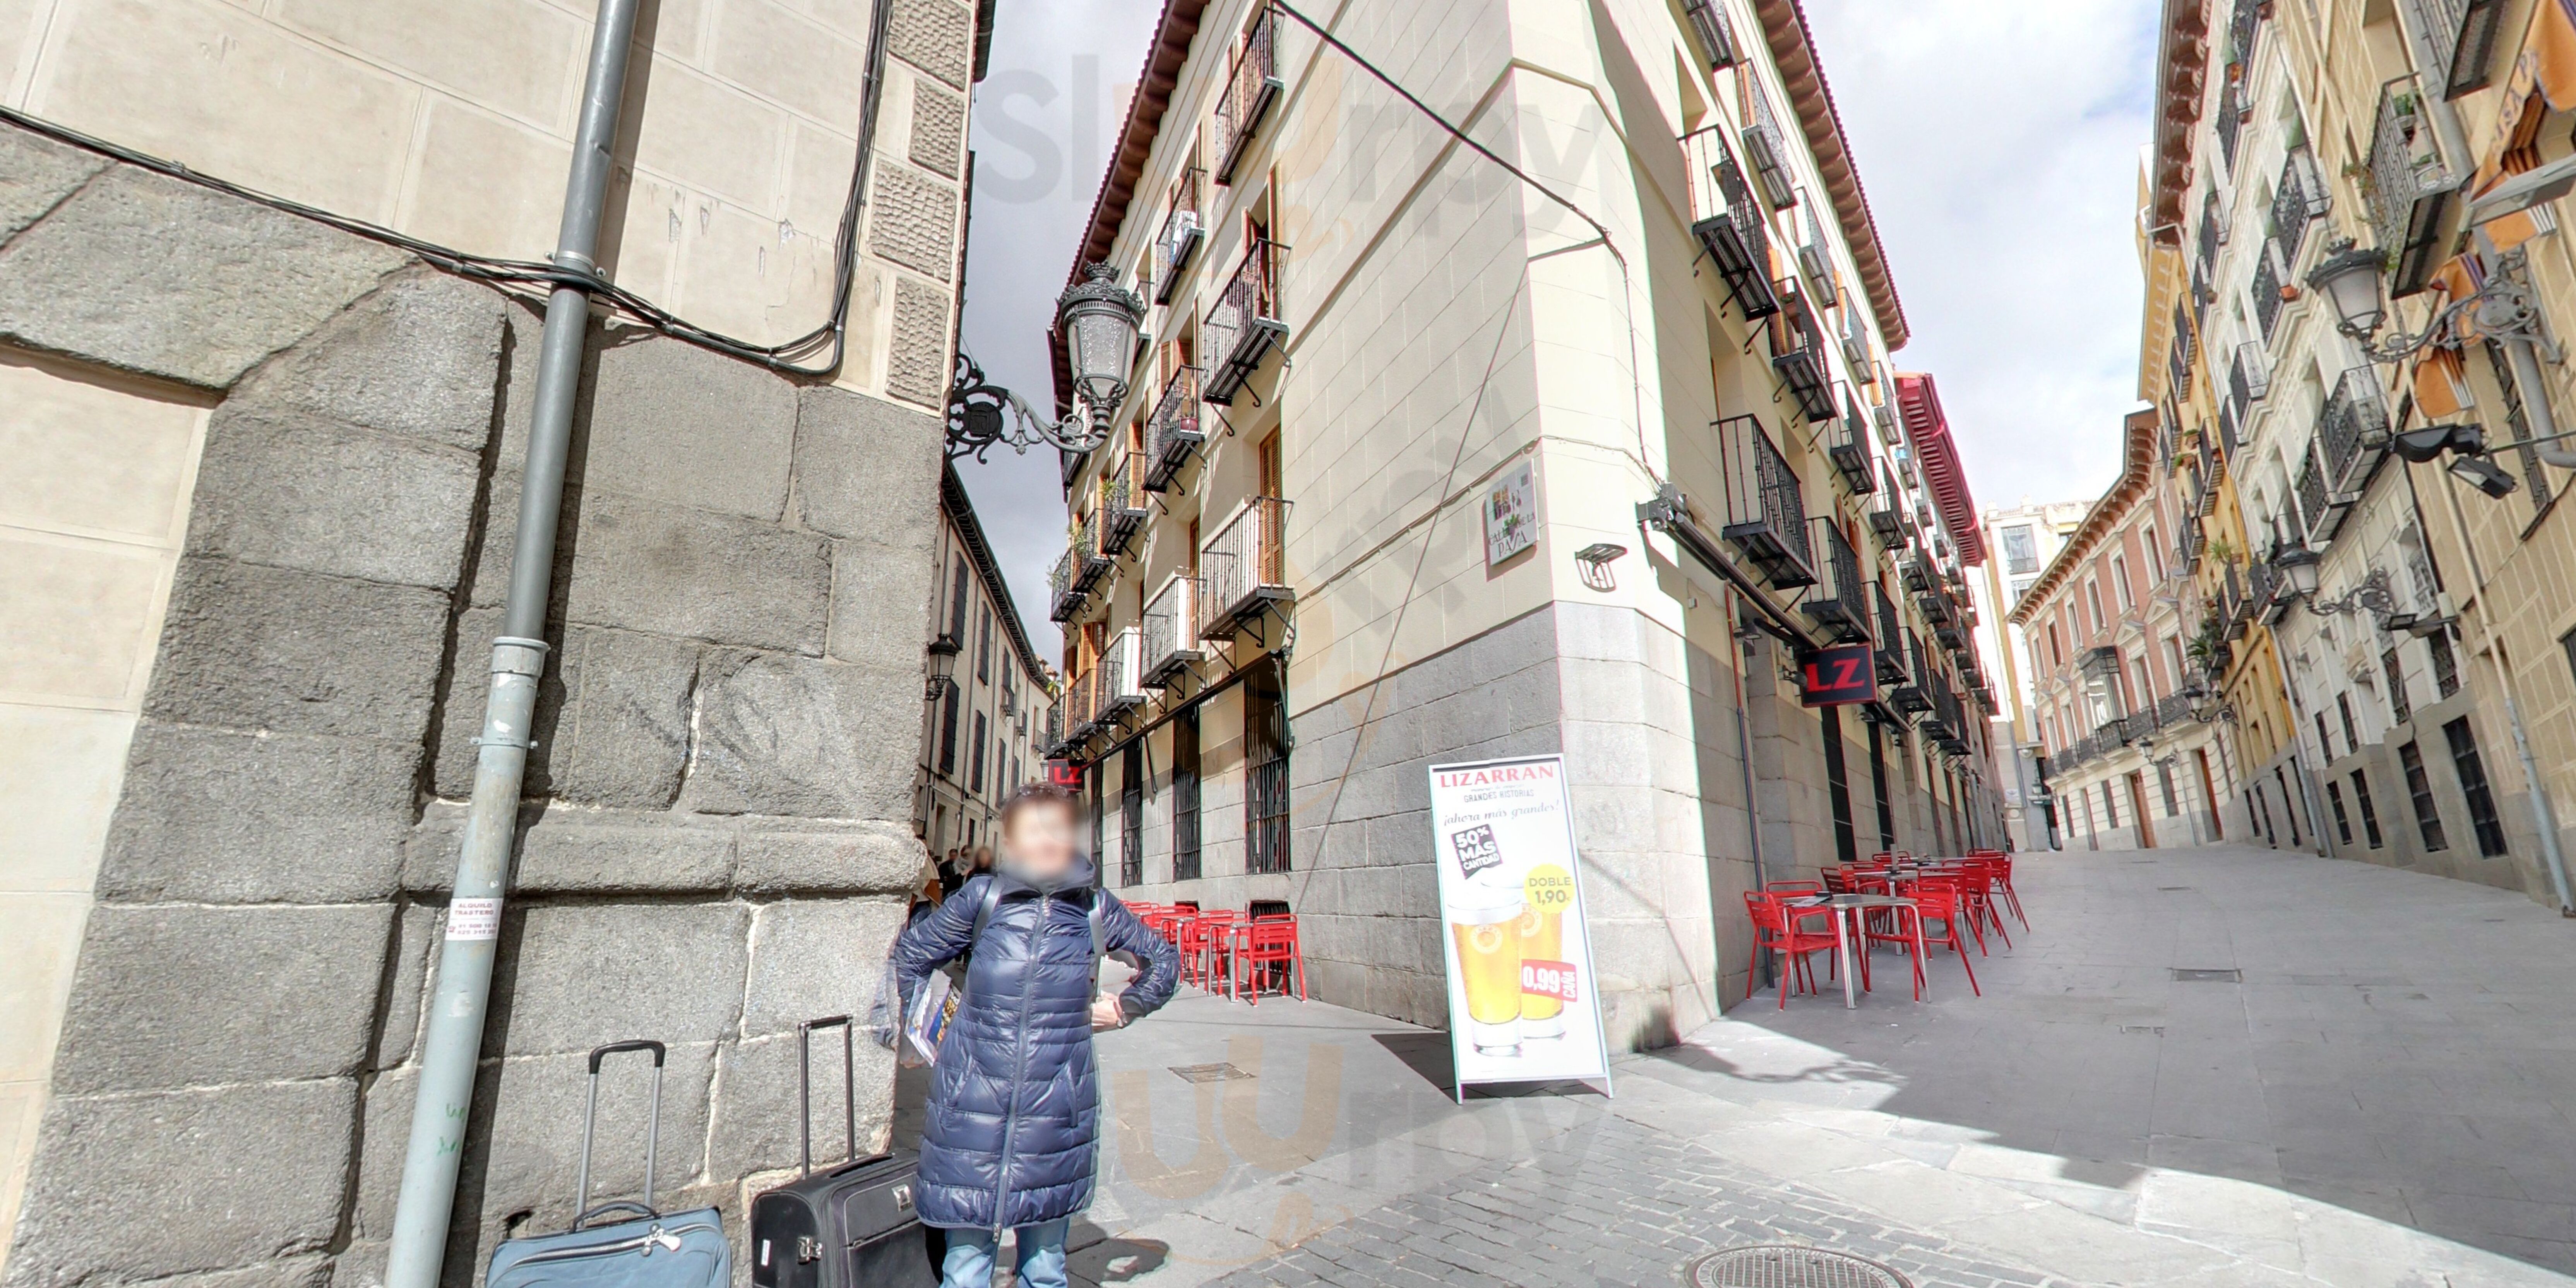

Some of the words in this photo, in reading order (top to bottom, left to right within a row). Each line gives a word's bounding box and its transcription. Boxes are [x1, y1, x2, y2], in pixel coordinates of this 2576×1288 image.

[1805, 658, 1865, 692] LZ
[1054, 767, 1082, 783] LZ
[1440, 765, 1553, 787] LIZARRAN
[1464, 792, 1497, 803] GRANDES
[1500, 790, 1534, 798] HISTORIAS
[1485, 809, 1507, 819] más
[1511, 800, 1559, 819] grandes!
[1456, 827, 1489, 848] 50%
[1463, 853, 1500, 870] CANTIDAD
[1529, 877, 1571, 887] DOBLE
[1523, 966, 1560, 993] 0,99
[1561, 971, 1576, 999] CAÑA
